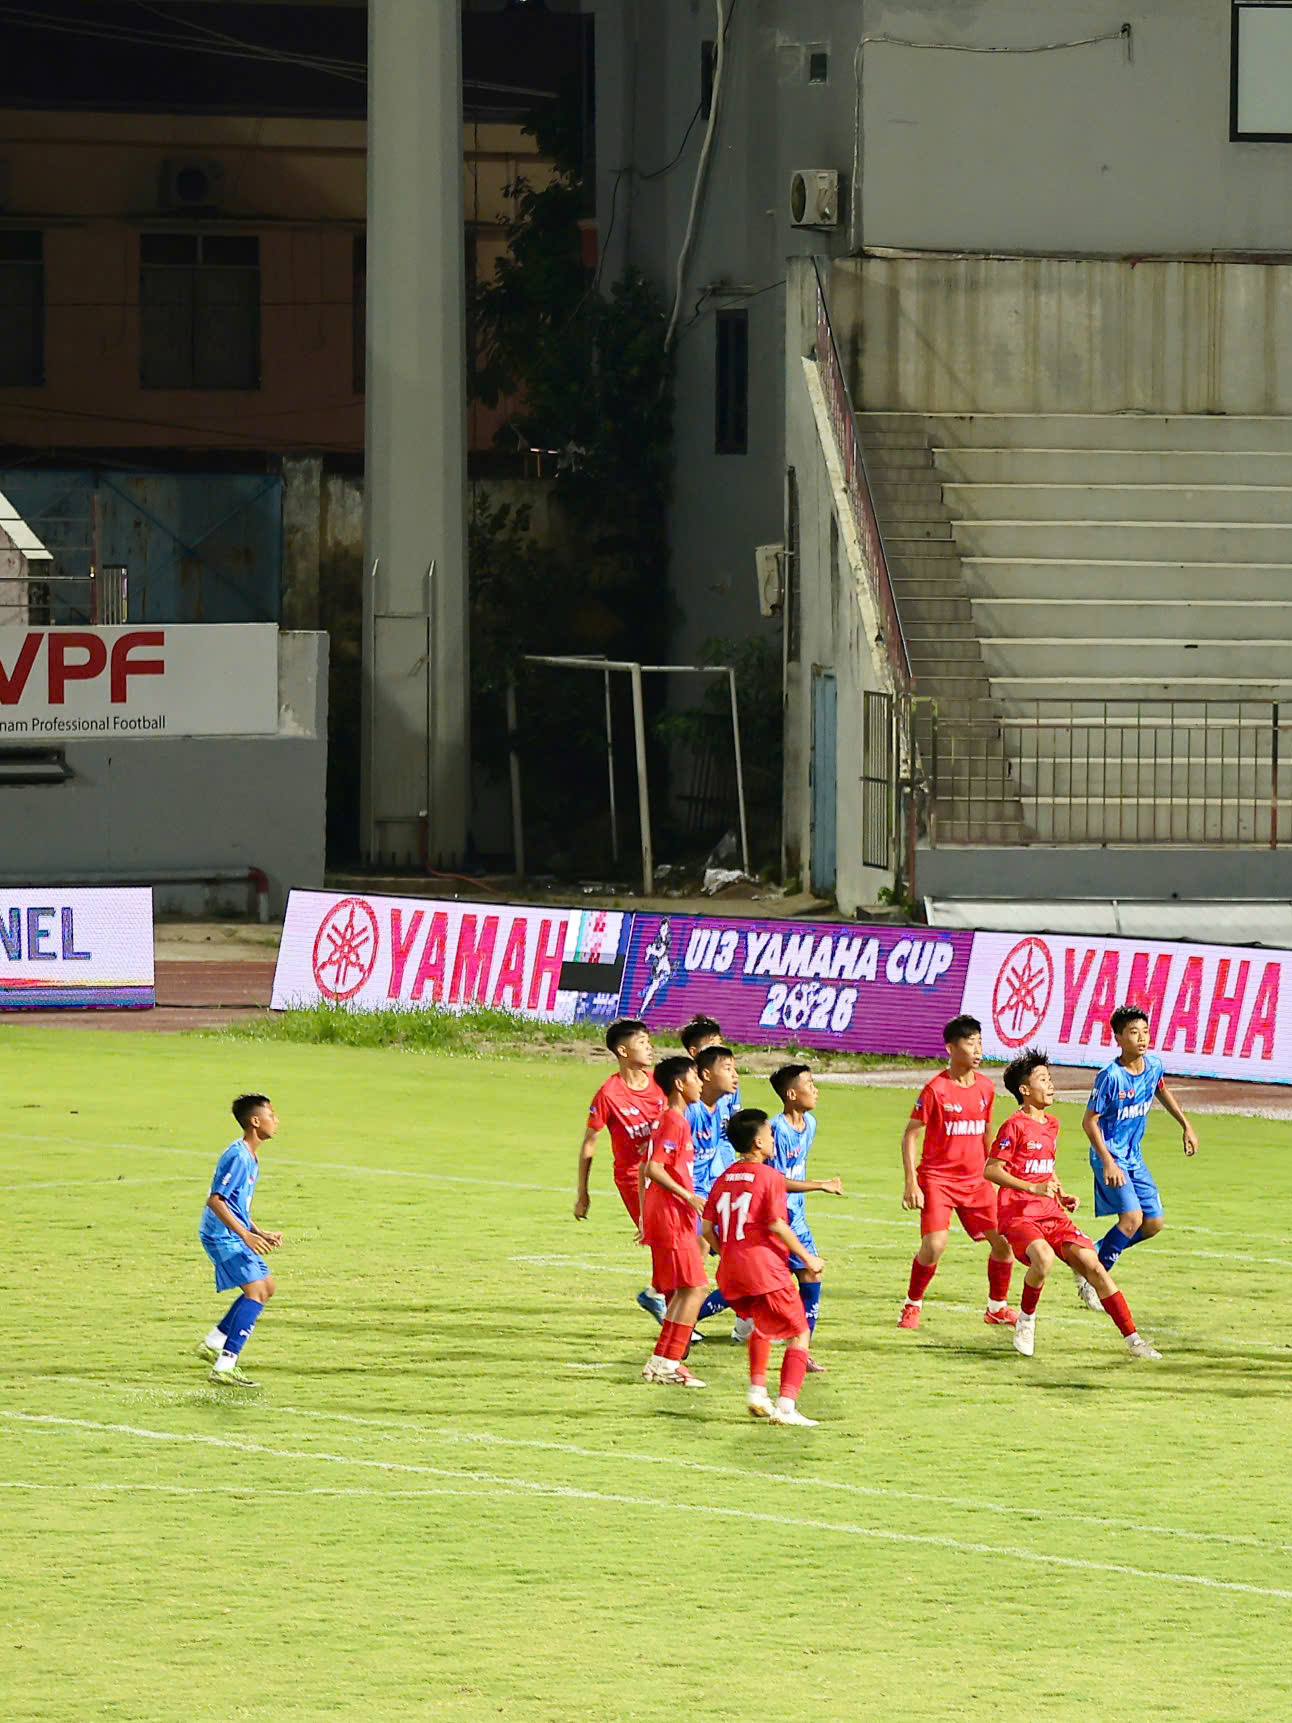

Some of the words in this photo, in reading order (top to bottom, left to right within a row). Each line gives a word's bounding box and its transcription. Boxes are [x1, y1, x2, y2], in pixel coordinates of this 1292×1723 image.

[32, 717, 109, 731] Professional
[113, 716, 166, 730] Football
[0, 906, 92, 961] NEL
[387, 908, 568, 1011] YAMAH
[684, 928, 739, 972] U13
[743, 932, 880, 982] YAMAHA
[885, 939, 954, 985] CUP
[759, 981, 859, 1033] 2026
[1058, 948, 1281, 1060] YAMAHA
[716, 1191, 753, 1243] 11
